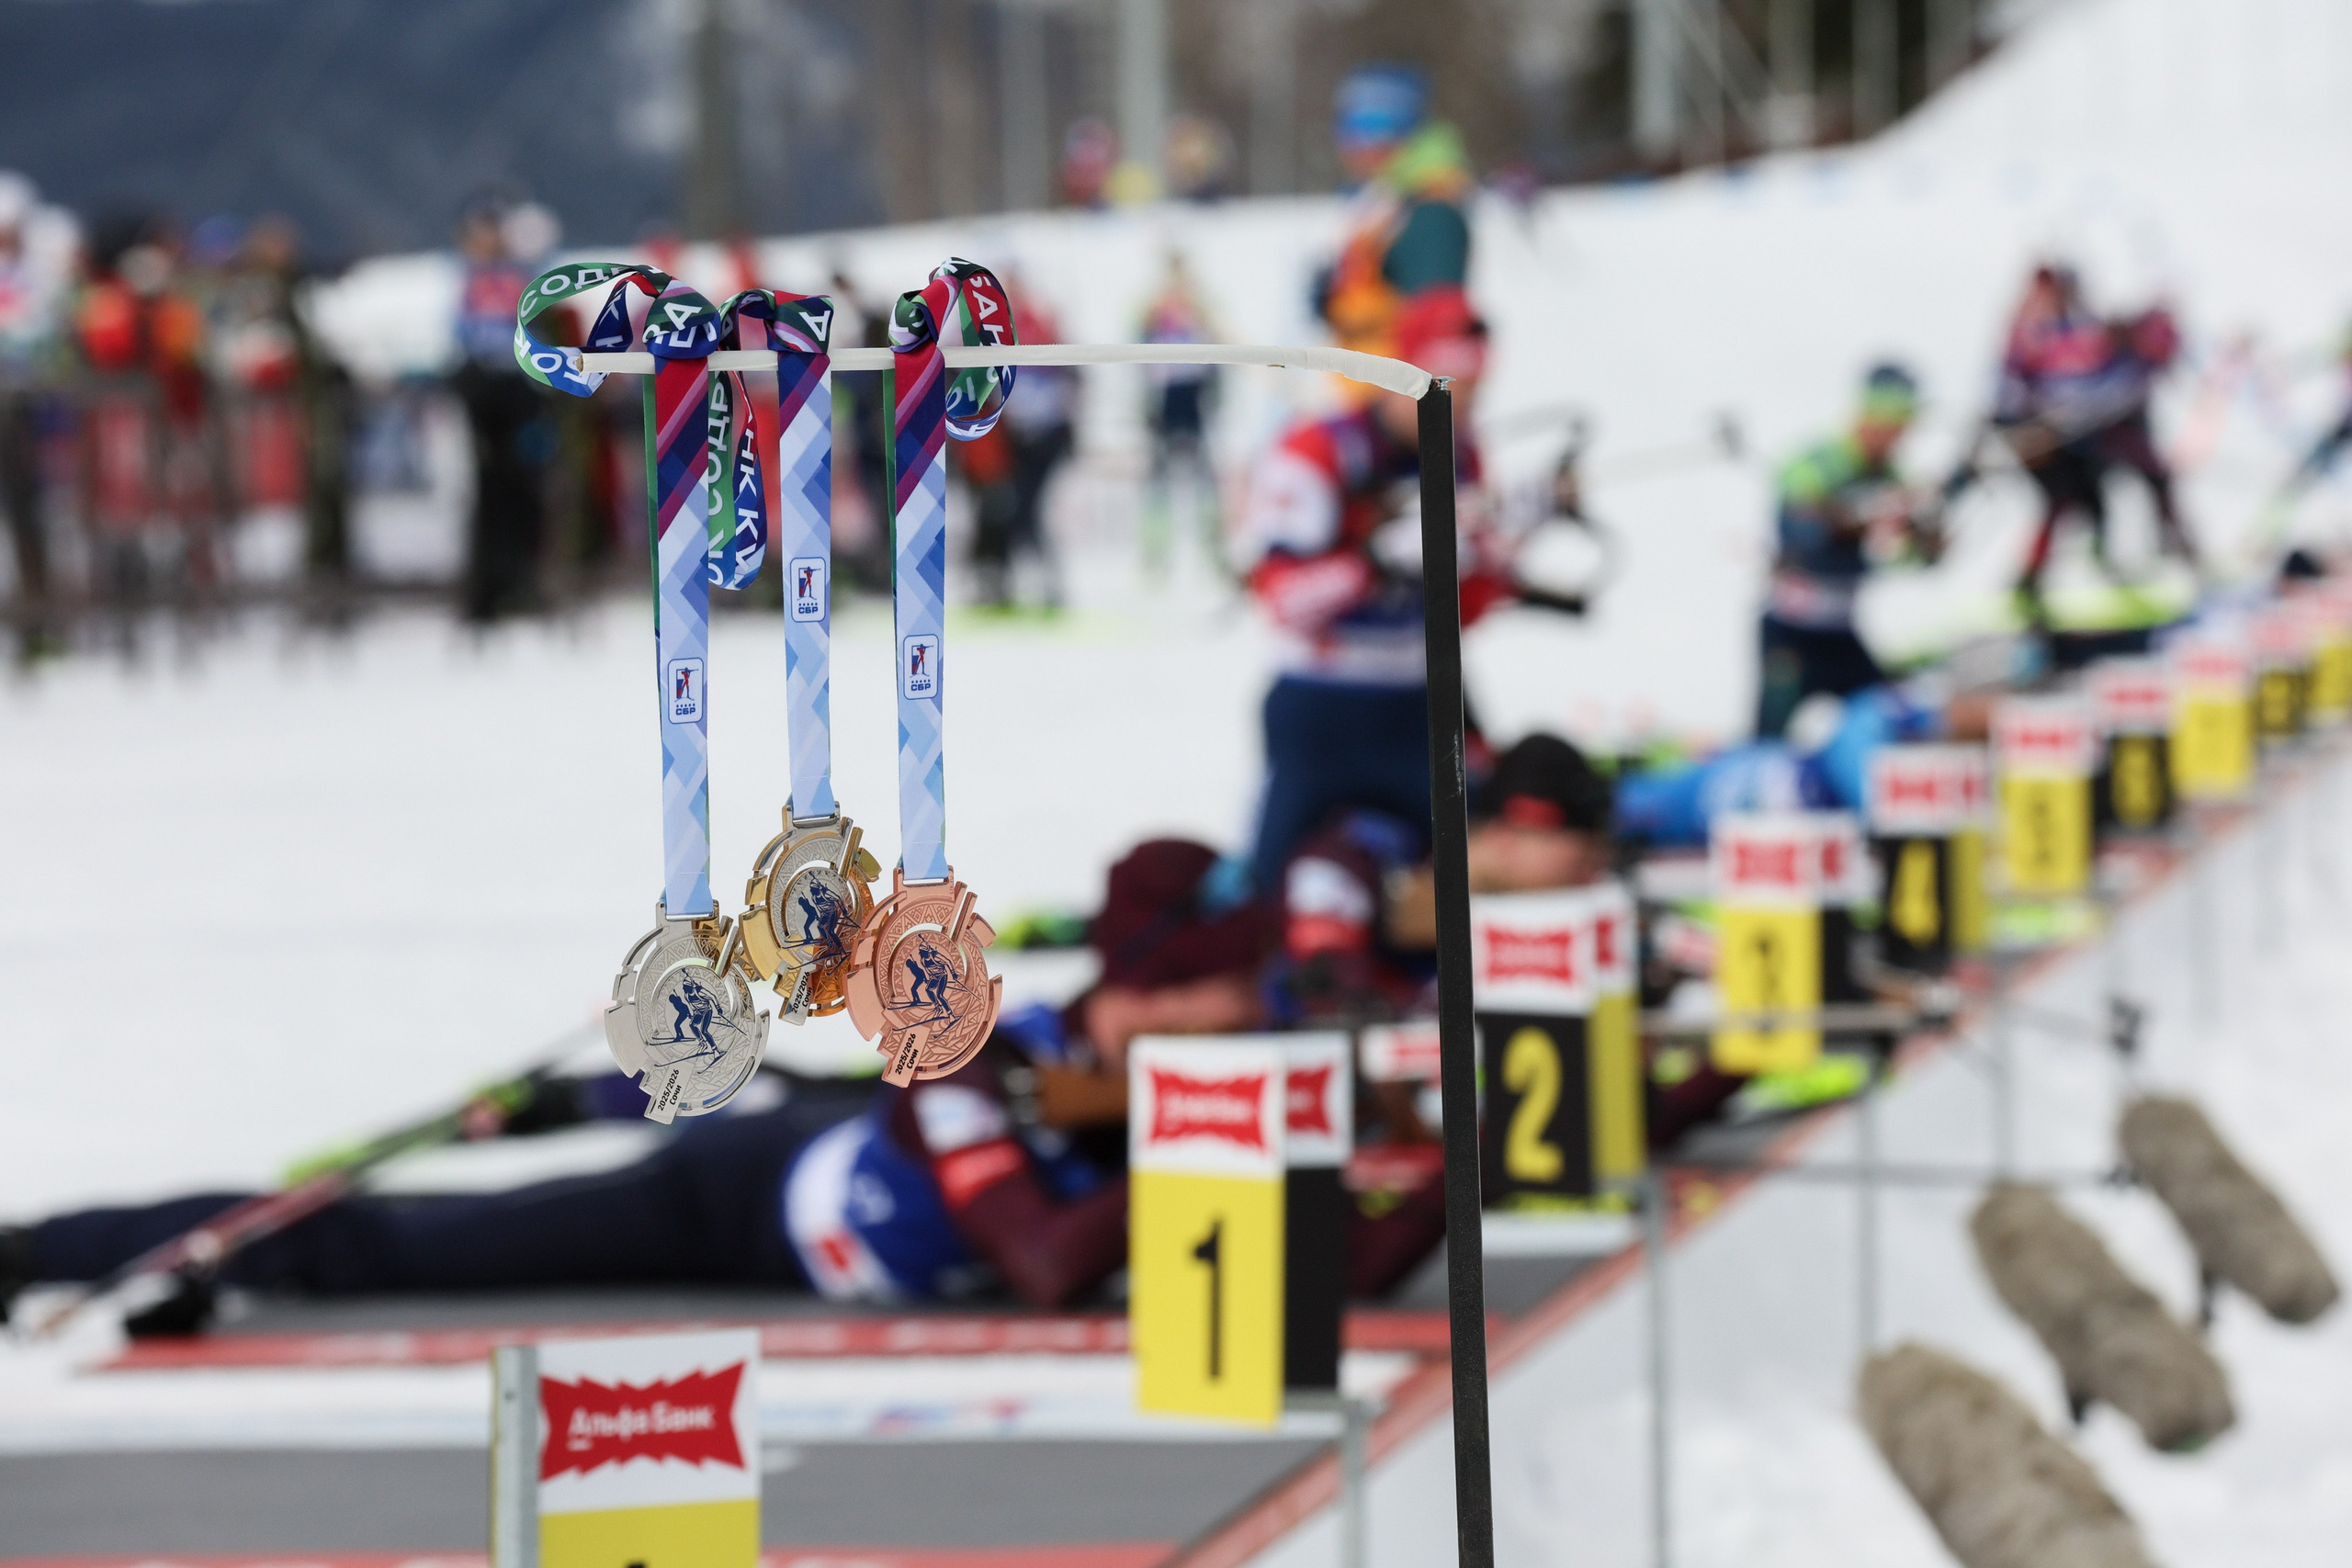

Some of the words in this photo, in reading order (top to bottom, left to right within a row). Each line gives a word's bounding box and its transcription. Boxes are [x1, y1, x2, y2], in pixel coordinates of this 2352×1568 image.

[797, 606, 819, 615] СБР
[910, 682, 931, 692] СБР
[675, 707, 695, 716] СБР
[792, 971, 809, 1013] 2025/2026
[802, 987, 813, 1008] Сочи
[895, 1033, 916, 1076] 2025/2026
[906, 1049, 919, 1069] Сочи
[658, 1069, 679, 1111] 2025/2026
[669, 1085, 682, 1105] Сочи
[1501, 1026, 1564, 1183] 2
[1186, 1213, 1224, 1382] 1
